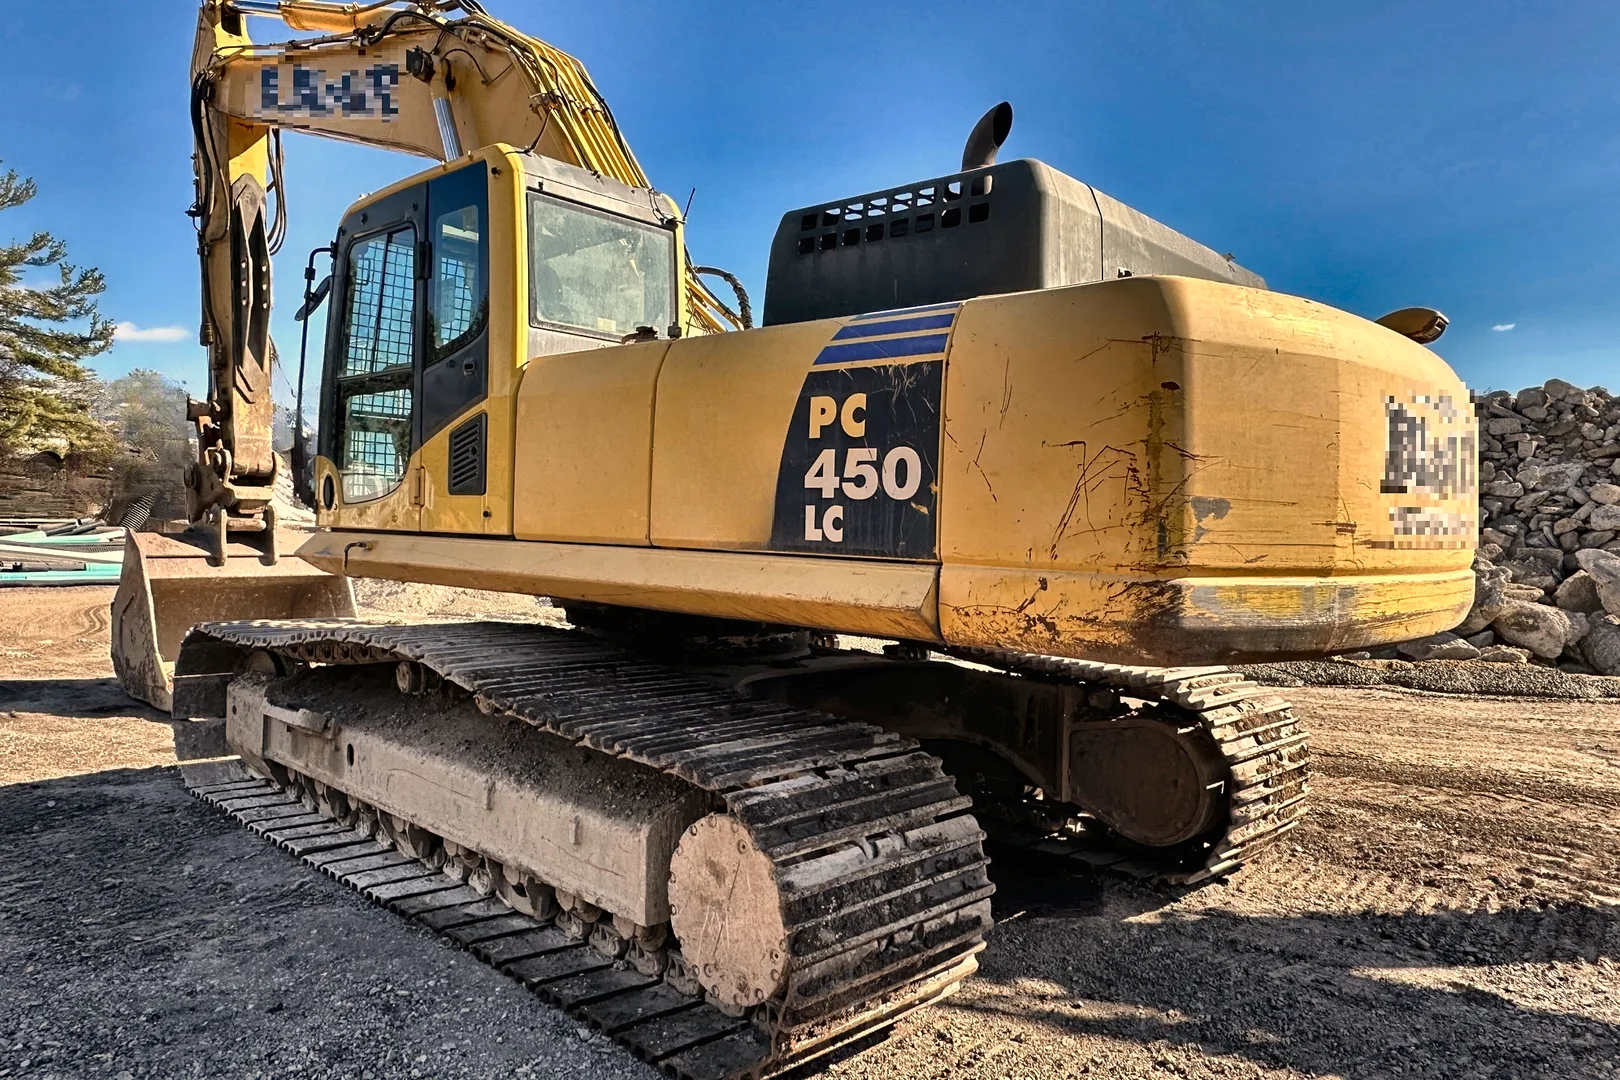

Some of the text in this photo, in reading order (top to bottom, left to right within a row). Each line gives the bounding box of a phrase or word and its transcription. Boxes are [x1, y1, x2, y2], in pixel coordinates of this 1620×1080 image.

[808, 393, 867, 439] PC
[804, 446, 922, 500] 450
[804, 505, 844, 542] LC
